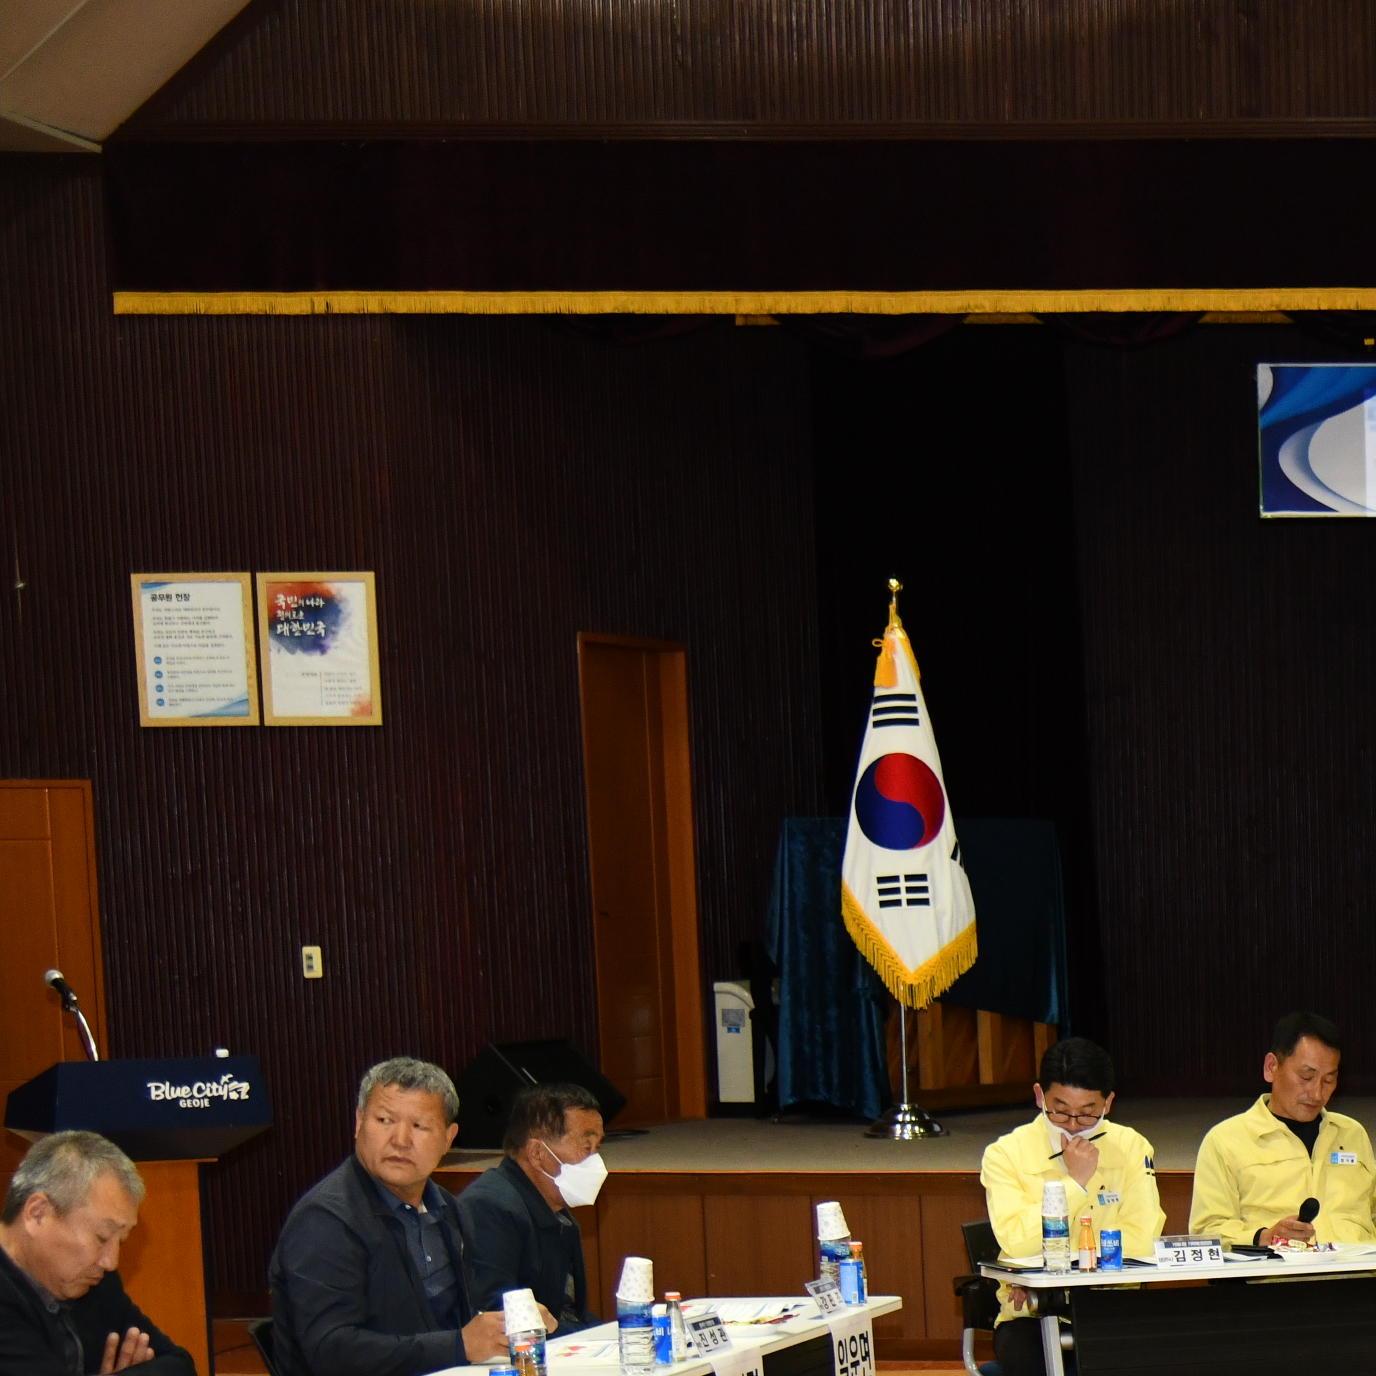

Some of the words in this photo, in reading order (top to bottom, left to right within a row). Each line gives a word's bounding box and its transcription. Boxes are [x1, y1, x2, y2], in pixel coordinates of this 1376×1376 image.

[146, 1081, 193, 1101] Blue
[193, 1076, 229, 1101] City
[179, 1098, 211, 1109] GEOJE
